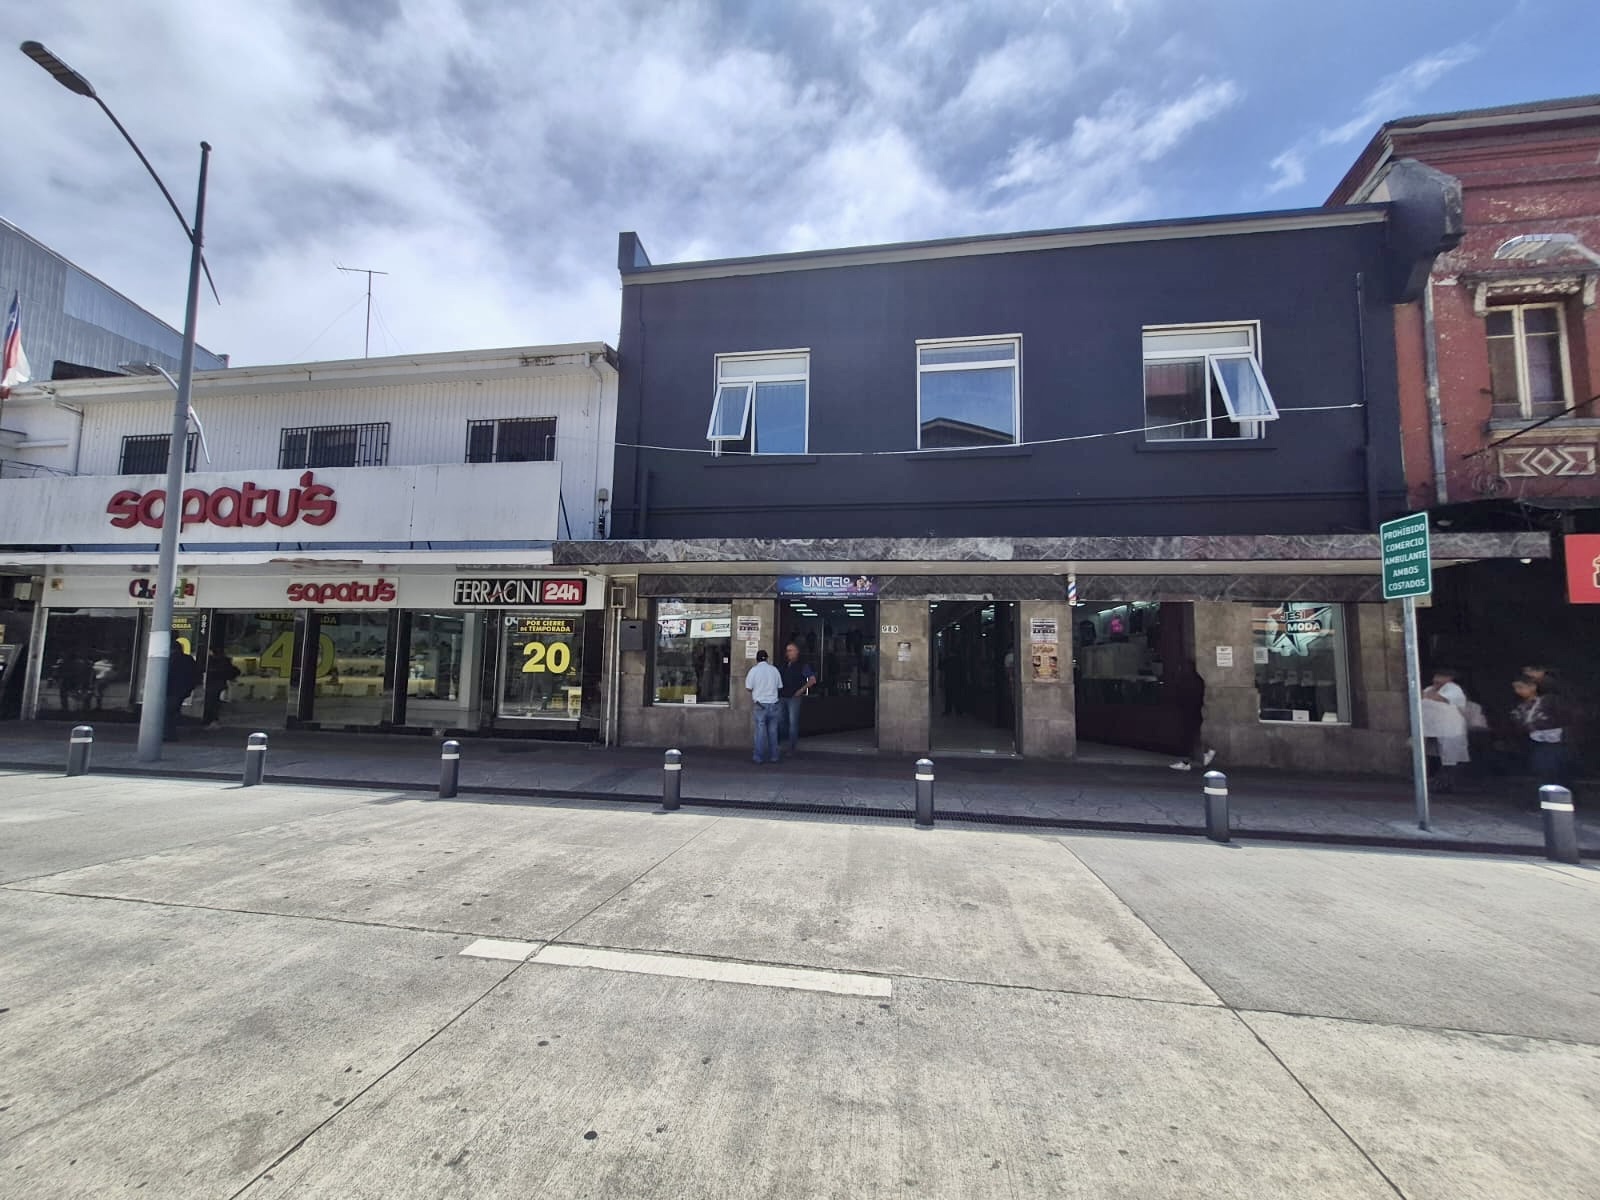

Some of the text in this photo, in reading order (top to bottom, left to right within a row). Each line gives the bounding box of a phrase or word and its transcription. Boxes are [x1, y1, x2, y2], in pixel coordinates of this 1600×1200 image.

[1383, 523, 1425, 540] PROHIBIDO
[1385, 537, 1425, 552] COMERCIO
[1384, 550, 1427, 565] AMBULANTE
[1392, 565, 1420, 577] AMBOS
[287, 578, 396, 604] sapatu's
[454, 580, 580, 603] FERRACINI 24h
[1388, 579, 1426, 591] COSTADOS
[1287, 621, 1321, 632] MODA
[522, 641, 571, 673] 20
